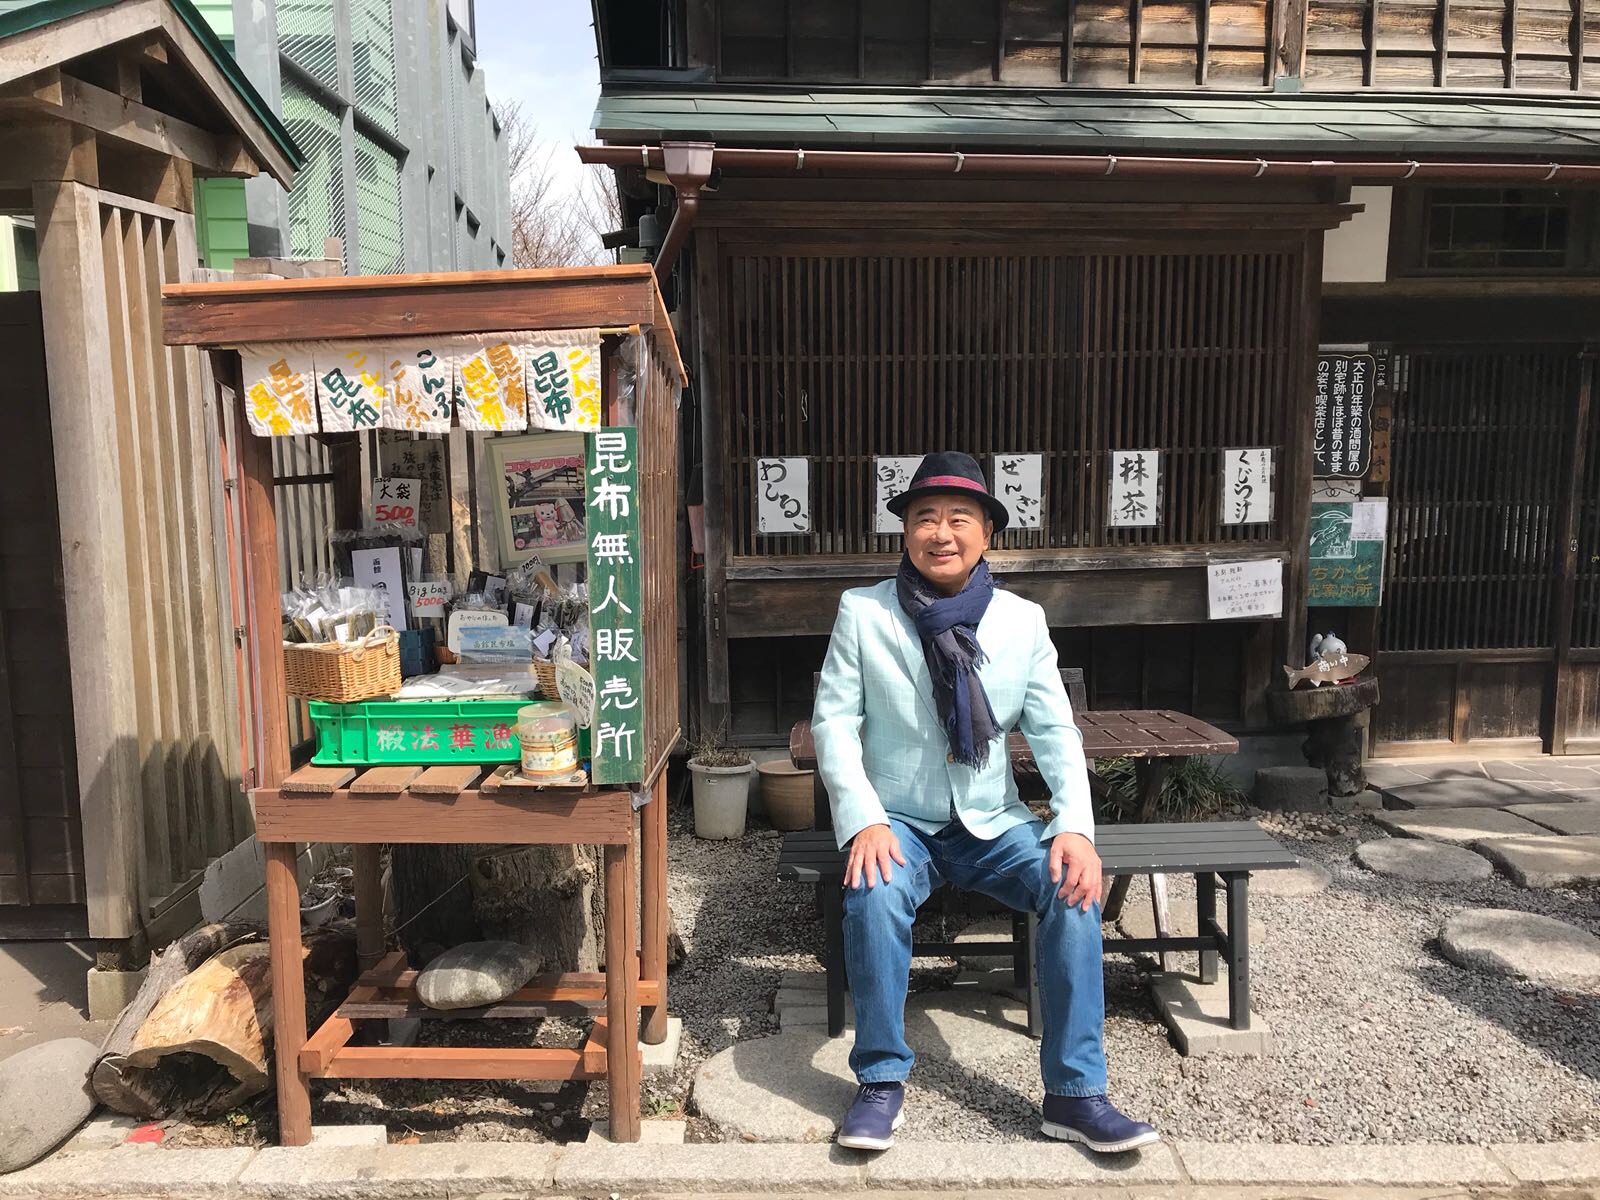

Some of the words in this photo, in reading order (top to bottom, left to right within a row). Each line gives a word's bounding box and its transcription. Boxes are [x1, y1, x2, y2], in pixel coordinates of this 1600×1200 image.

[249, 383, 291, 436] 昆布
[268, 358, 311, 424] 昆布
[322, 368, 380, 429] 昆布
[390, 360, 430, 428] こんぶ
[417, 350, 465, 419] こんぶ
[461, 357, 506, 430] 昆布
[485, 341, 527, 418] 昆布
[532, 351, 573, 424] 昆布
[1313, 361, 1330, 466] の姿で喫茶店として、
[1330, 360, 1348, 473] 別宅跡をほぼ昔のまま
[1348, 359, 1366, 472] 大正10年築の酒問屋の
[380, 482, 411, 500] 大袋
[877, 465, 904, 501] 白玉
[1001, 457, 1039, 527] ぜんざい
[1119, 453, 1150, 521] 抹茶
[1234, 450, 1254, 523] くじら汁
[408, 585, 429, 598] Big
[430, 583, 449, 594] bag
[590, 432, 638, 760] 昆布無人販売所
[1311, 564, 1373, 580] ちかど
